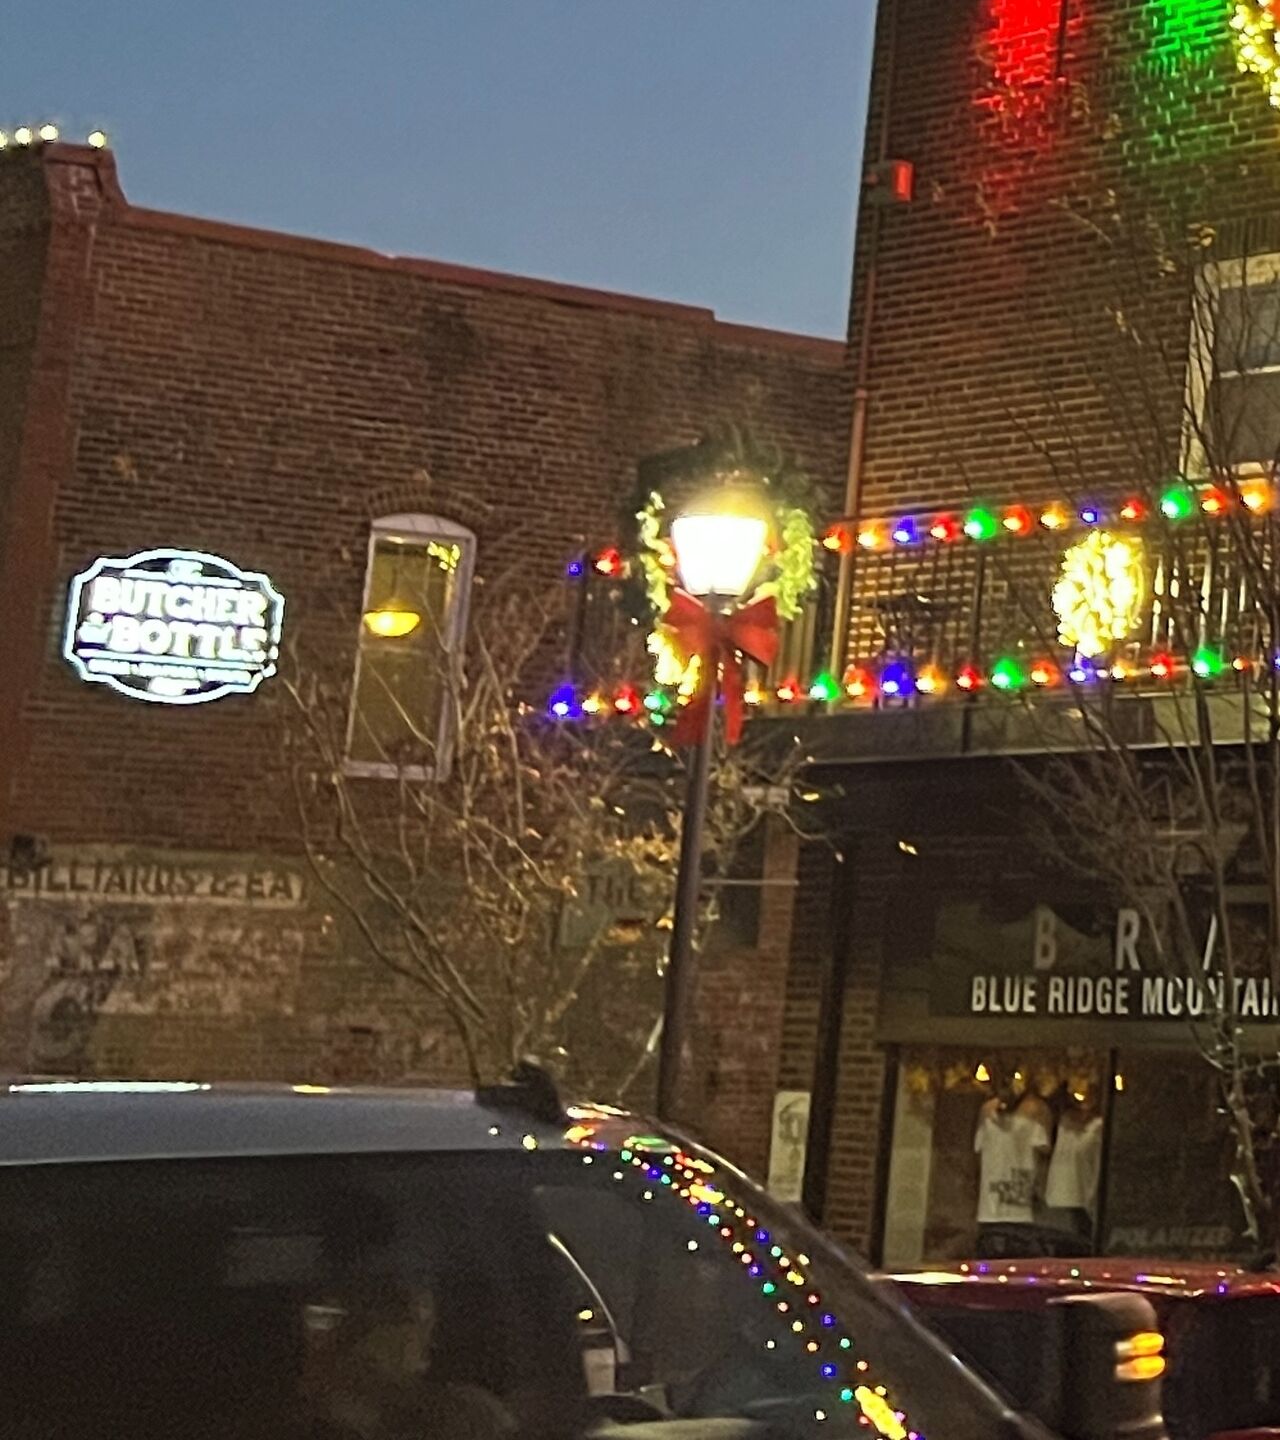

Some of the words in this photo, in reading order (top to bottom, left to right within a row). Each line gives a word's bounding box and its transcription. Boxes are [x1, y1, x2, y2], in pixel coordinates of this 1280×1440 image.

[92, 575, 268, 626] BUTCHER
[108, 615, 269, 664] BOTTLE
[971, 975, 1038, 1013] BLUE
[1047, 976, 1129, 1015] RIDGE
